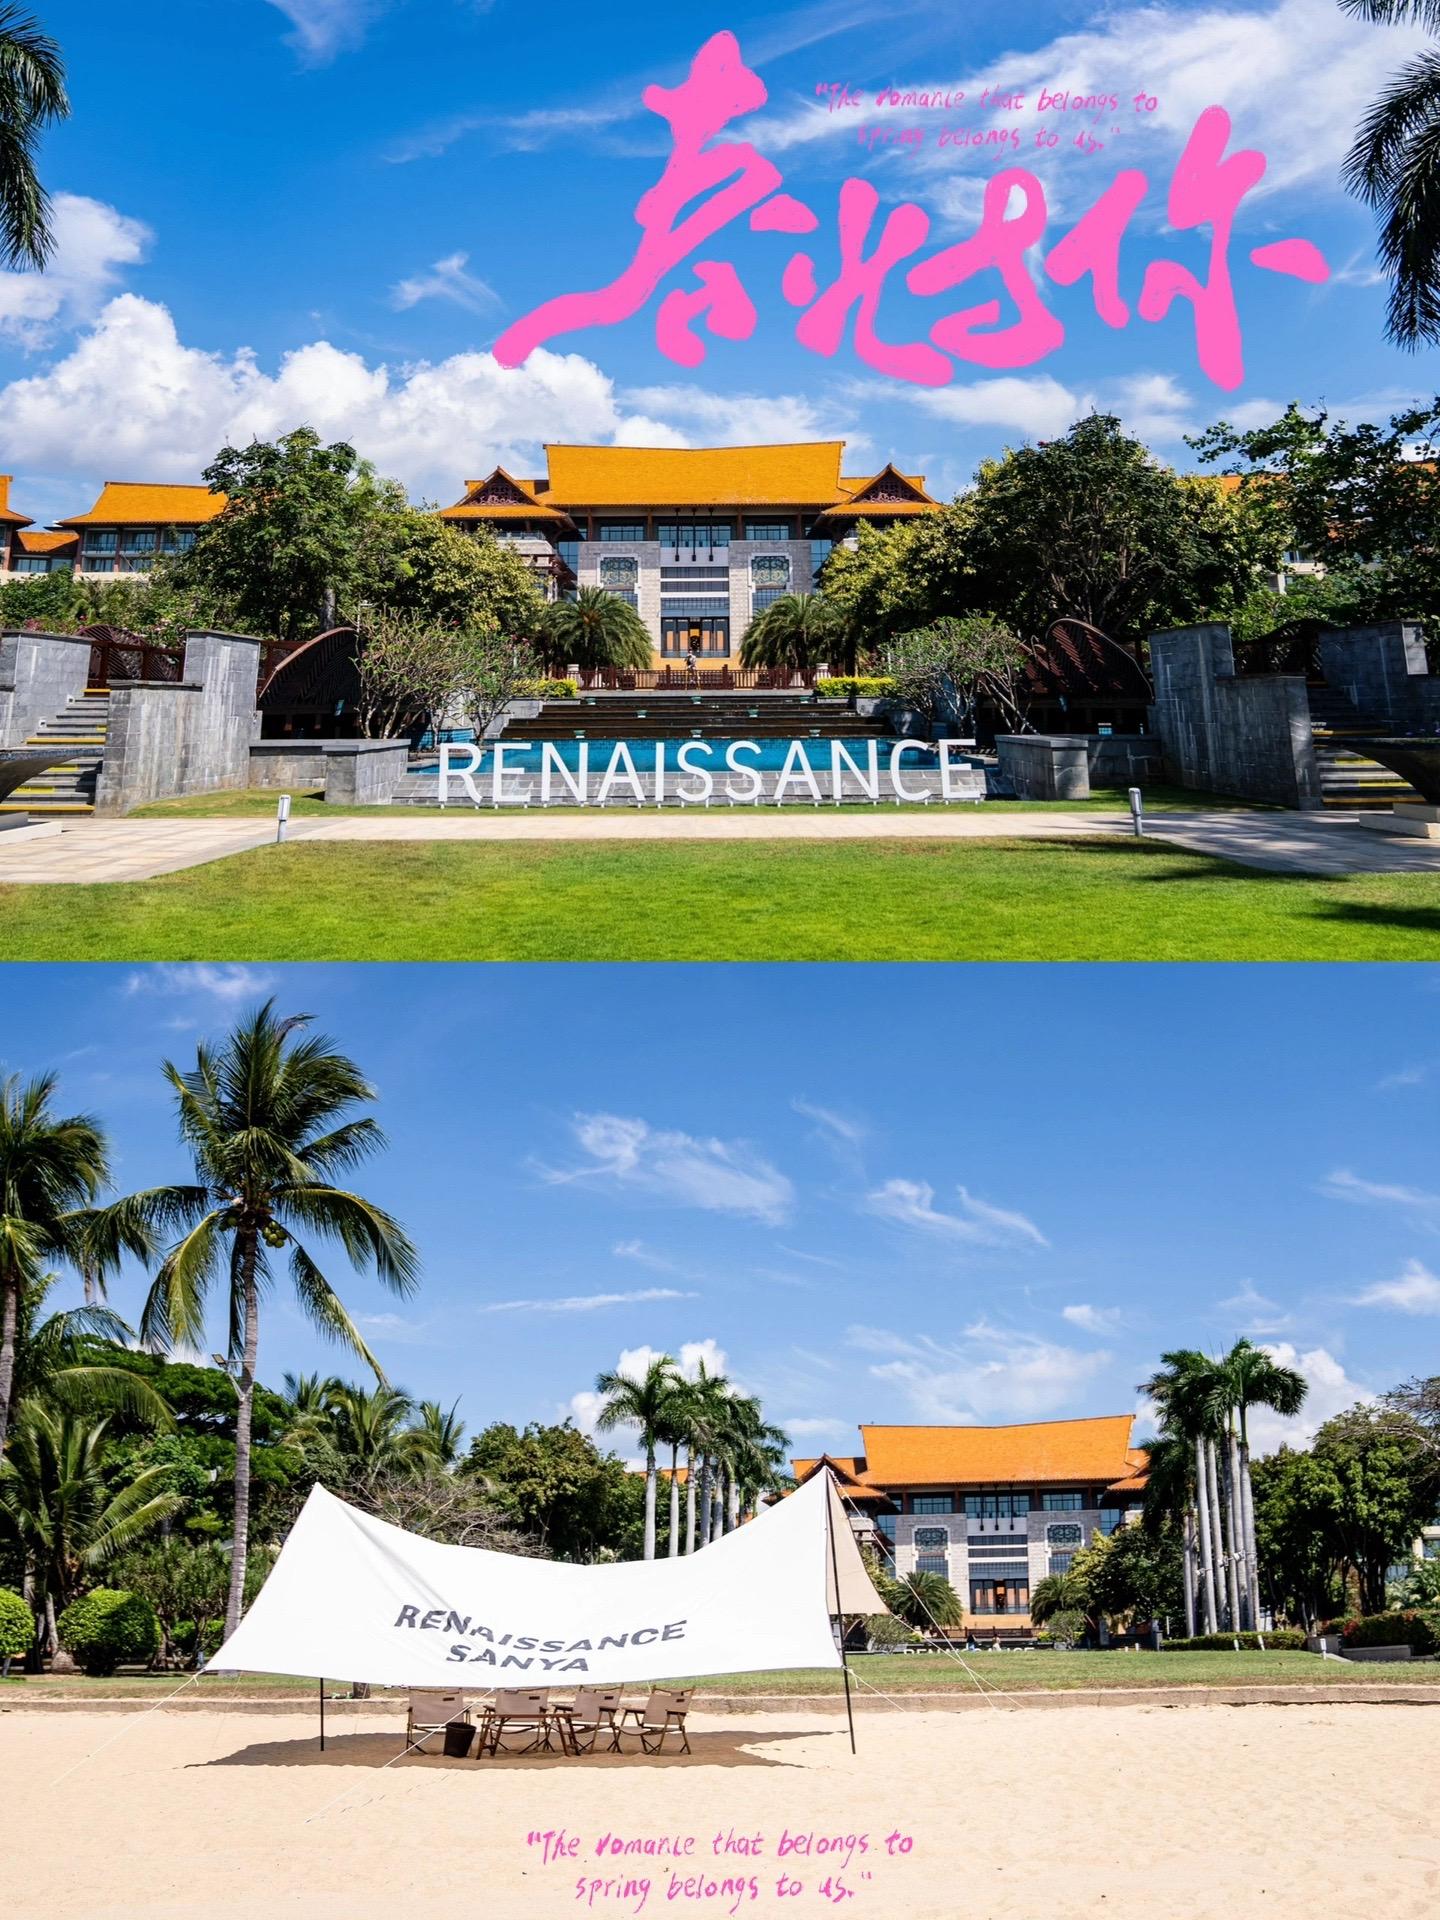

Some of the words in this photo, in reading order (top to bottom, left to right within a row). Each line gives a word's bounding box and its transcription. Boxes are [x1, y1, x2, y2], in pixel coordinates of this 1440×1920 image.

[437, 738, 978, 806] RENAISSANCE
[394, 1604, 688, 1653] RENAISSANCE
[446, 1644, 590, 1672] SANYA
